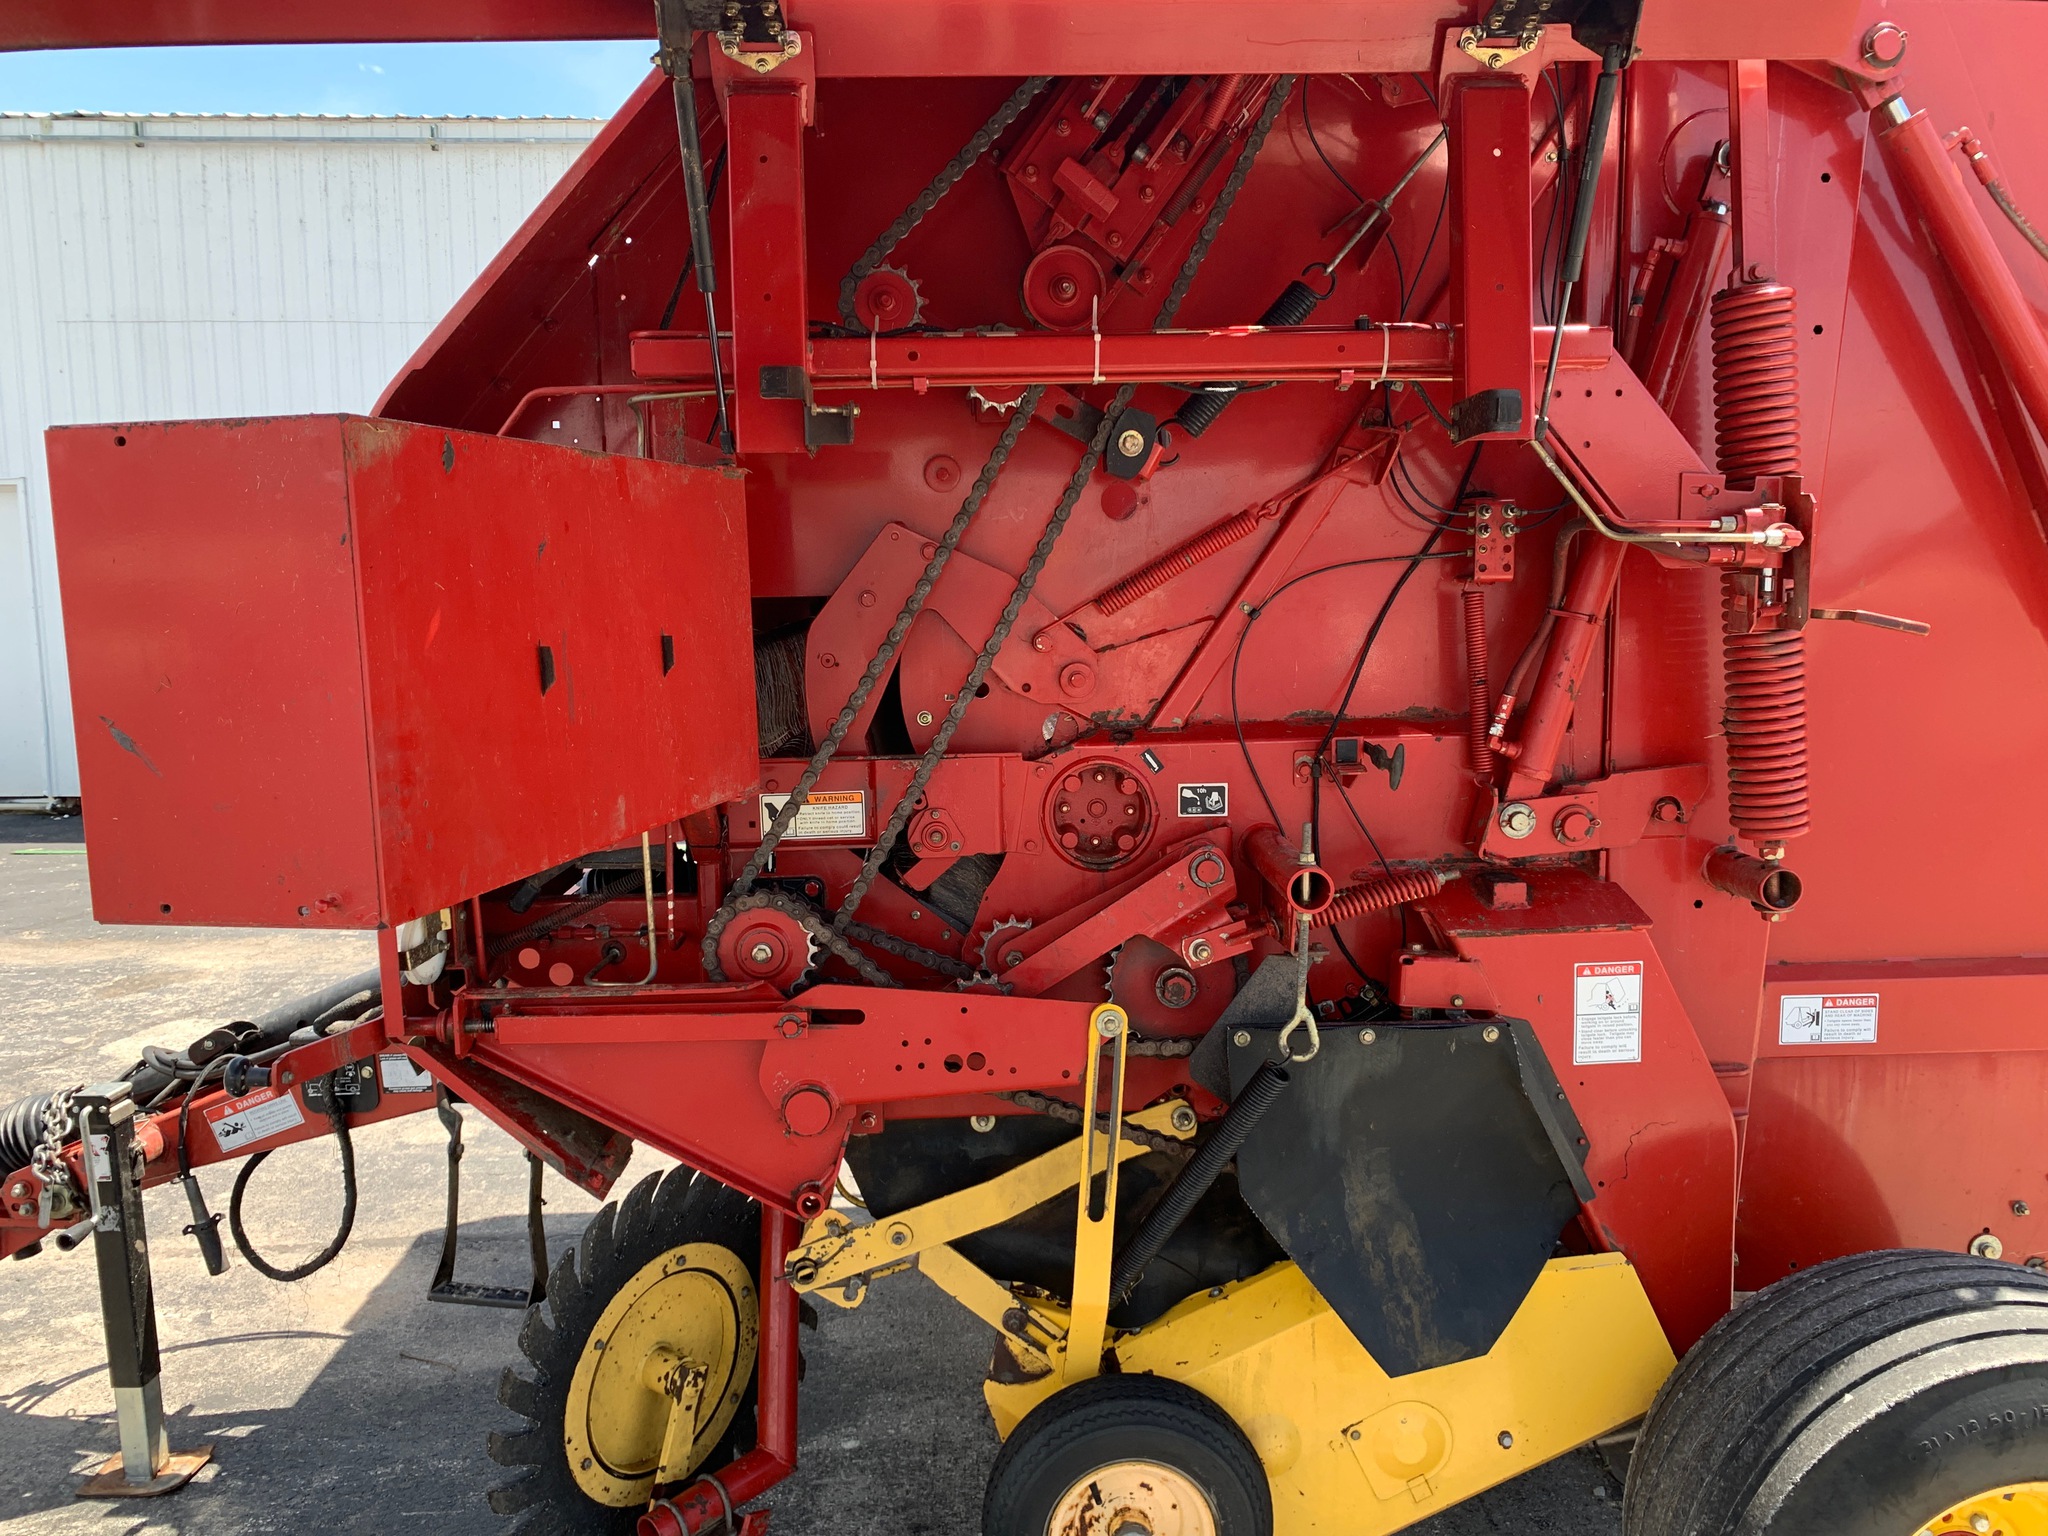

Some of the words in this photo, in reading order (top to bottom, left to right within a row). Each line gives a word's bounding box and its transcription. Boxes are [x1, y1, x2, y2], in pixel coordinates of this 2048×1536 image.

[814, 794, 854, 802] WARNING
[1594, 966, 1634, 974] DANGER
[236, 1090, 274, 1110] DANGER
